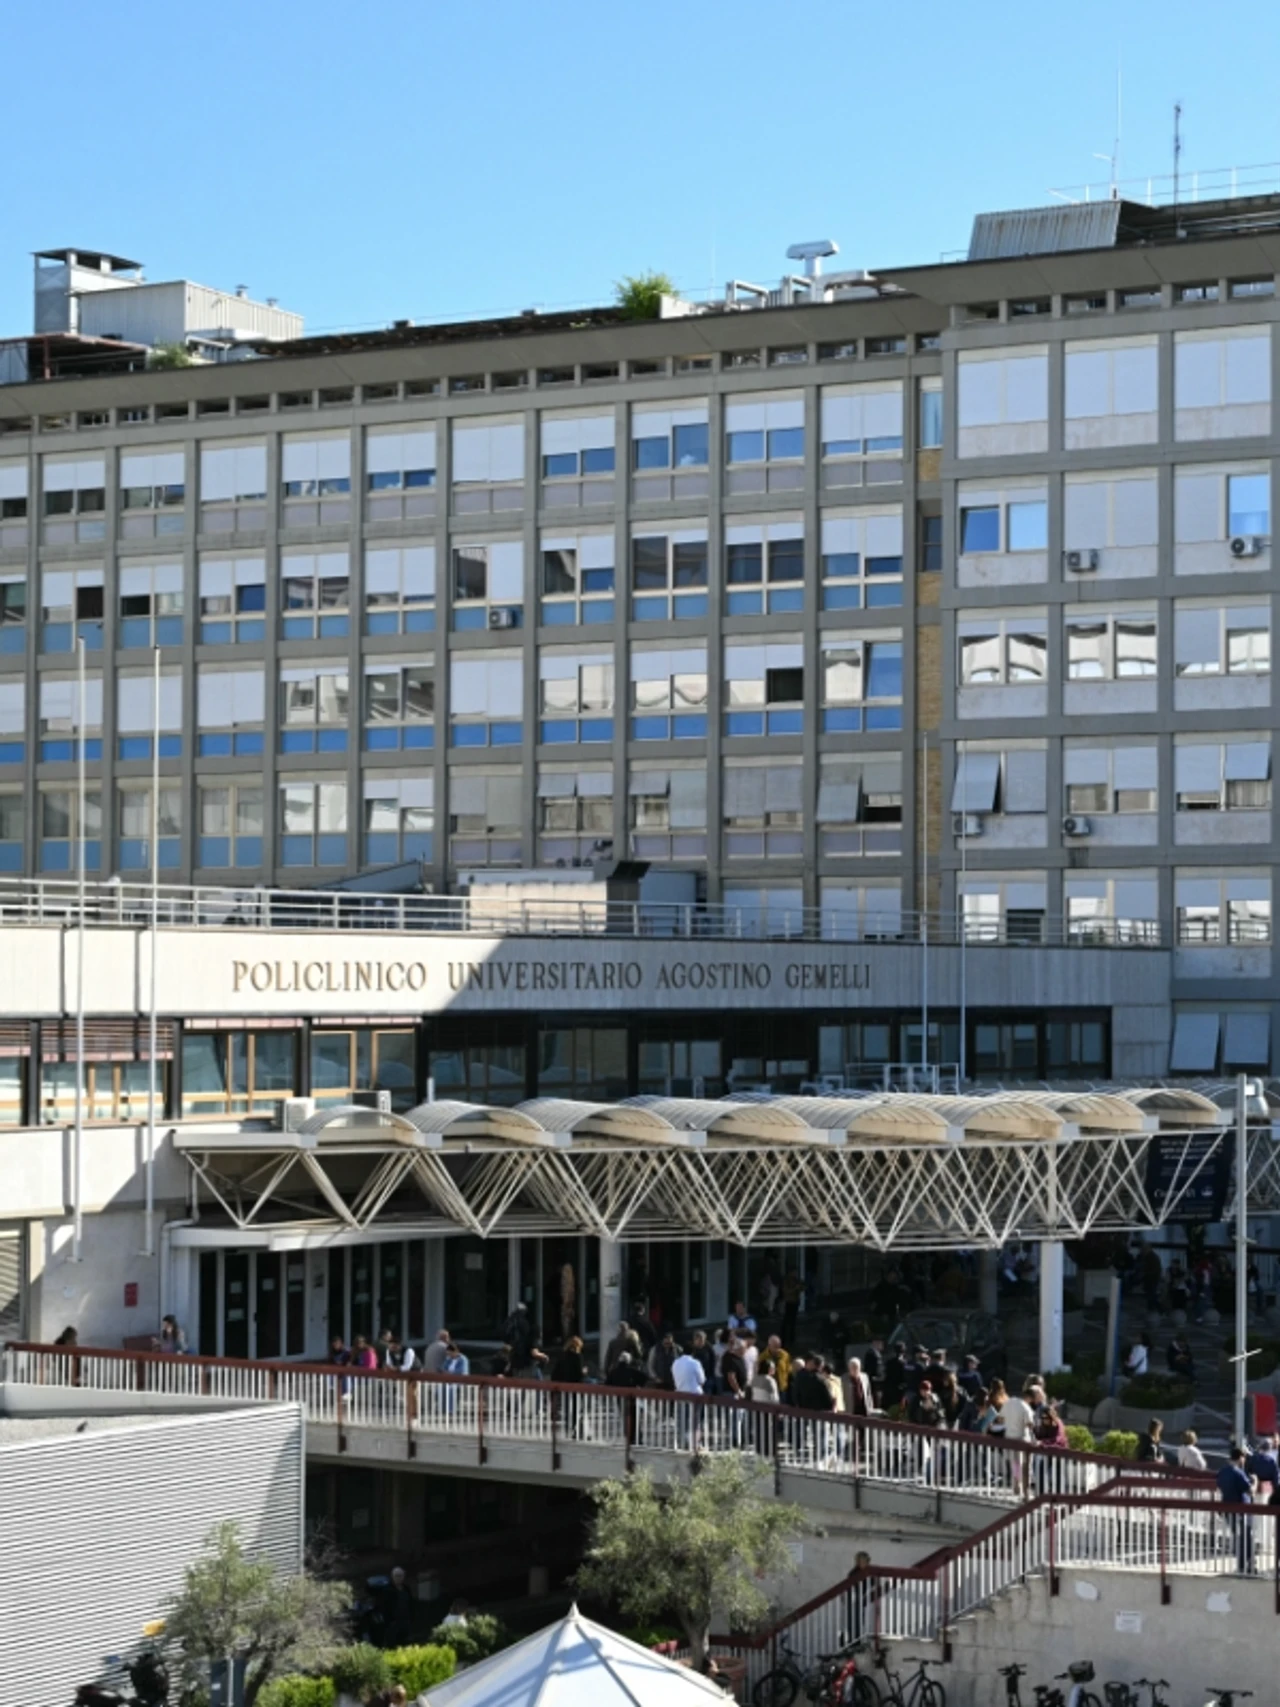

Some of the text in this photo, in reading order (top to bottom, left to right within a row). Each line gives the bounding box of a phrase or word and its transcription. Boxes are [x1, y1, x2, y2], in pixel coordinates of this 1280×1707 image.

[232, 960, 871, 993] POLICLINICO UNIVERSITARIO AGOSTINO GEMELLI
